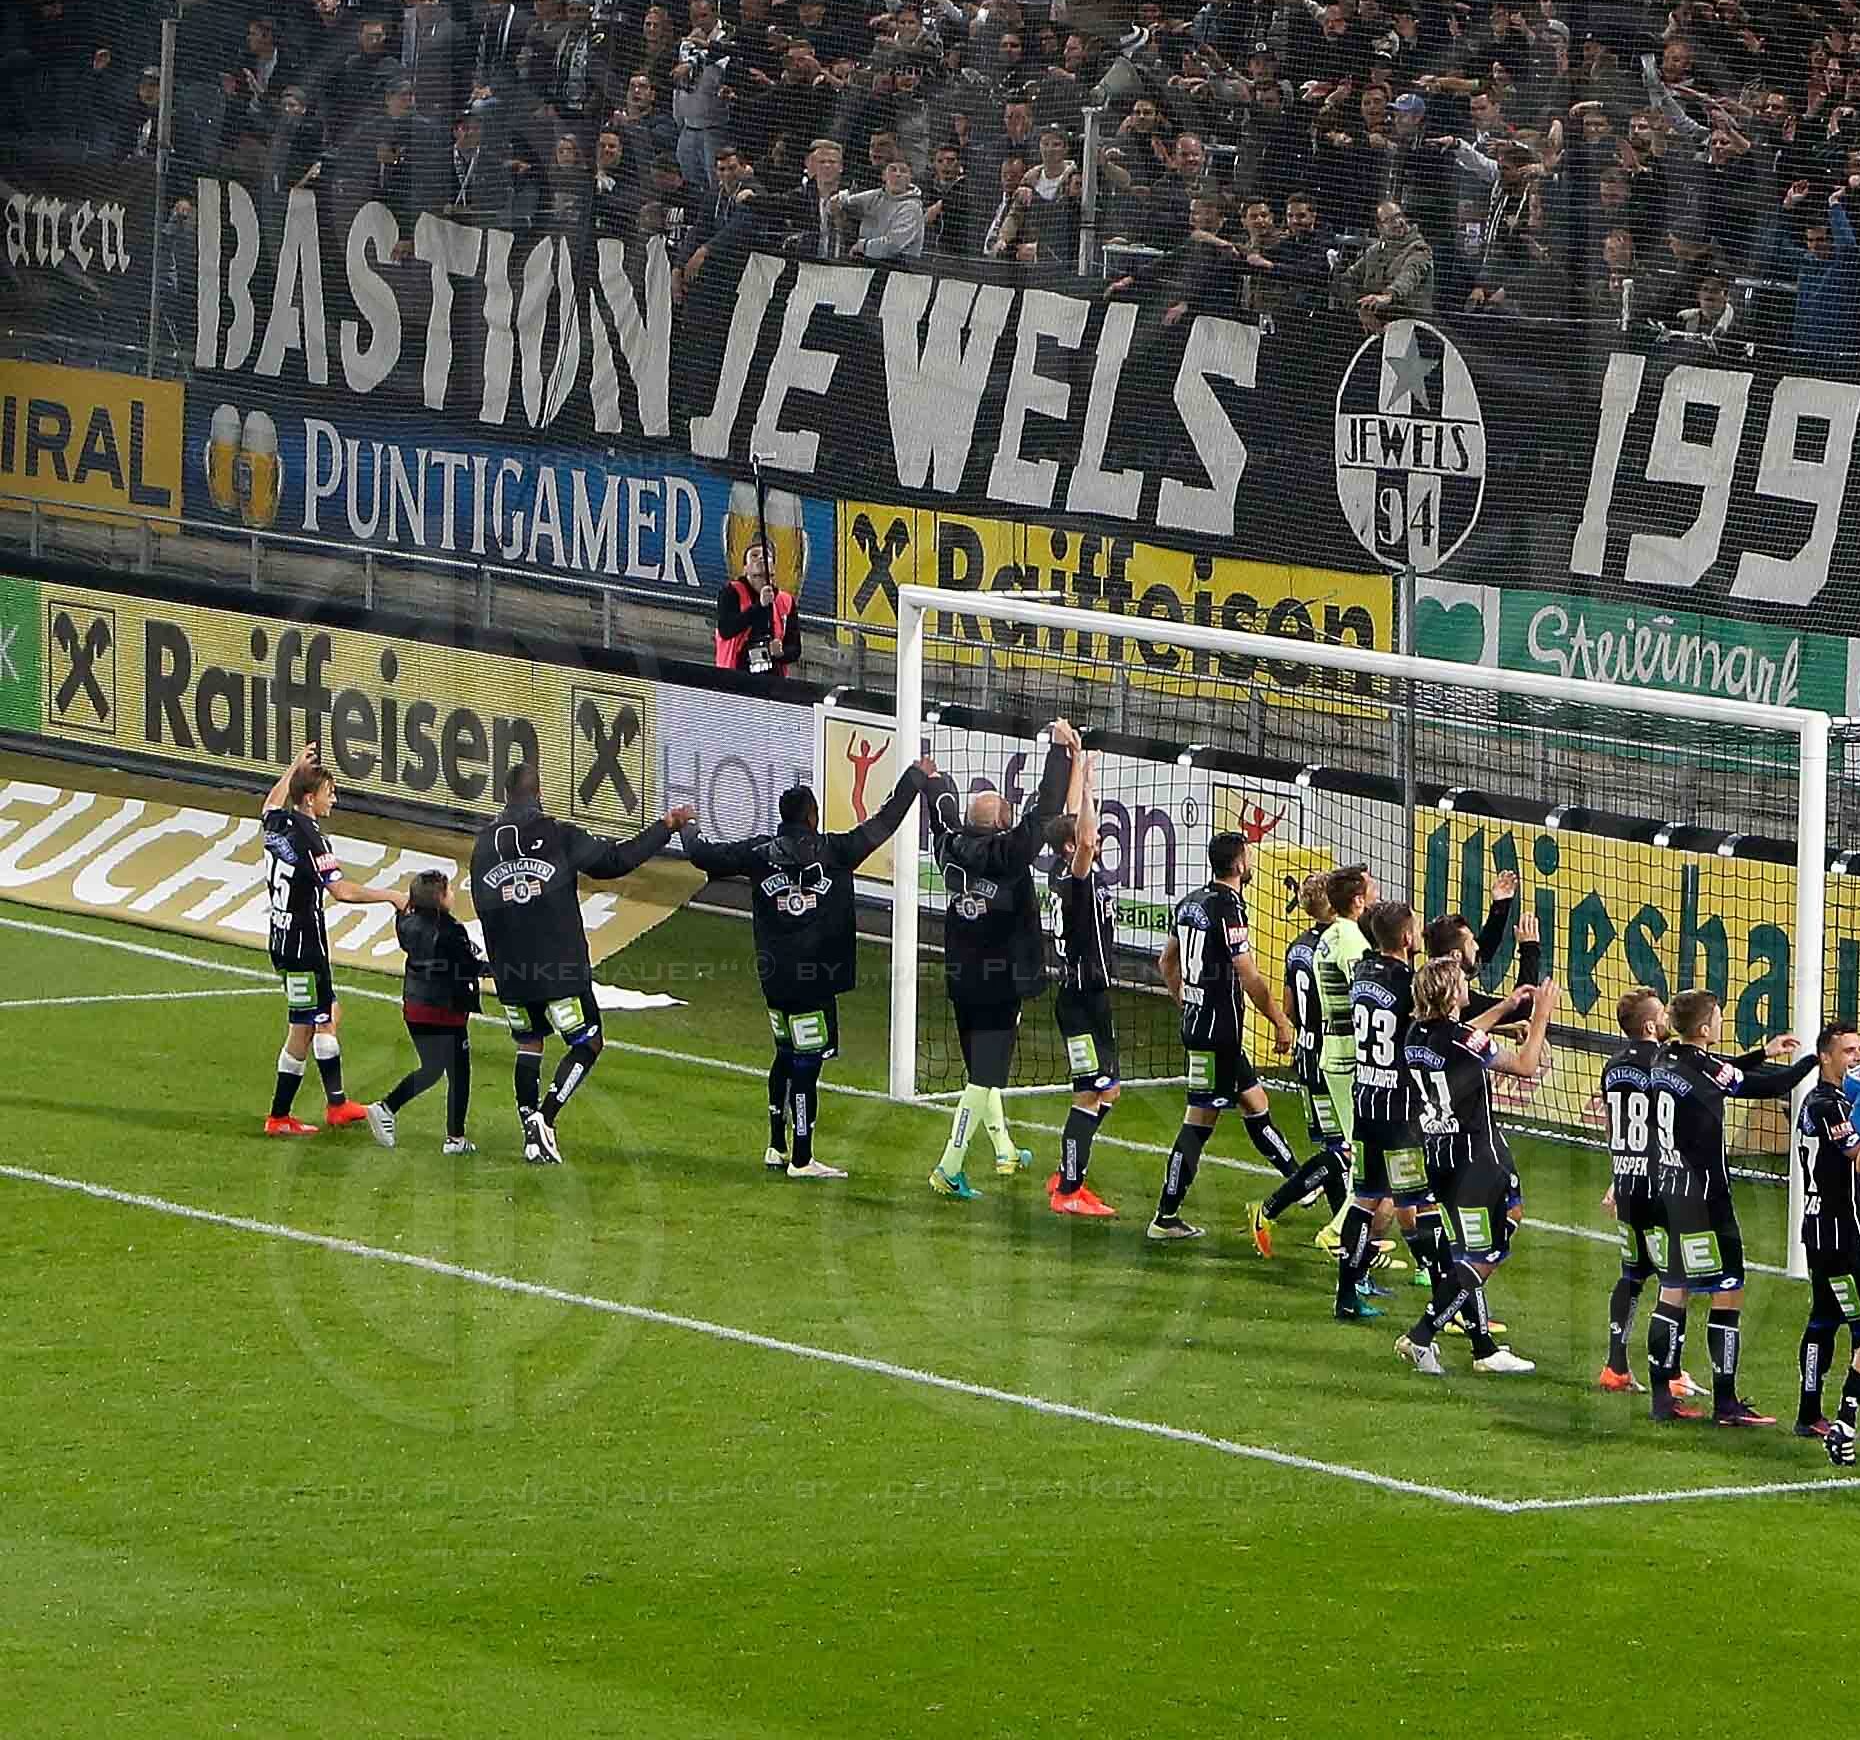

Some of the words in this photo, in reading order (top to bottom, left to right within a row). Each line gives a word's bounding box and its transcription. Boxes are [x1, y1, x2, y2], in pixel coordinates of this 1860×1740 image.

[195, 177, 673, 438] BASTION
[689, 251, 1261, 537] JEWELS
[1344, 416, 1471, 474] JEWELS
[302, 416, 703, 590] PUNTIGAMER
[1377, 488, 1437, 549] 94
[935, 516, 1379, 695] Raiffeisen
[144, 618, 539, 804] Raiffeisen
[1353, 1006, 1398, 1068] 23
[1607, 1091, 1650, 1152] 18
[1656, 1091, 1676, 1152] 9
